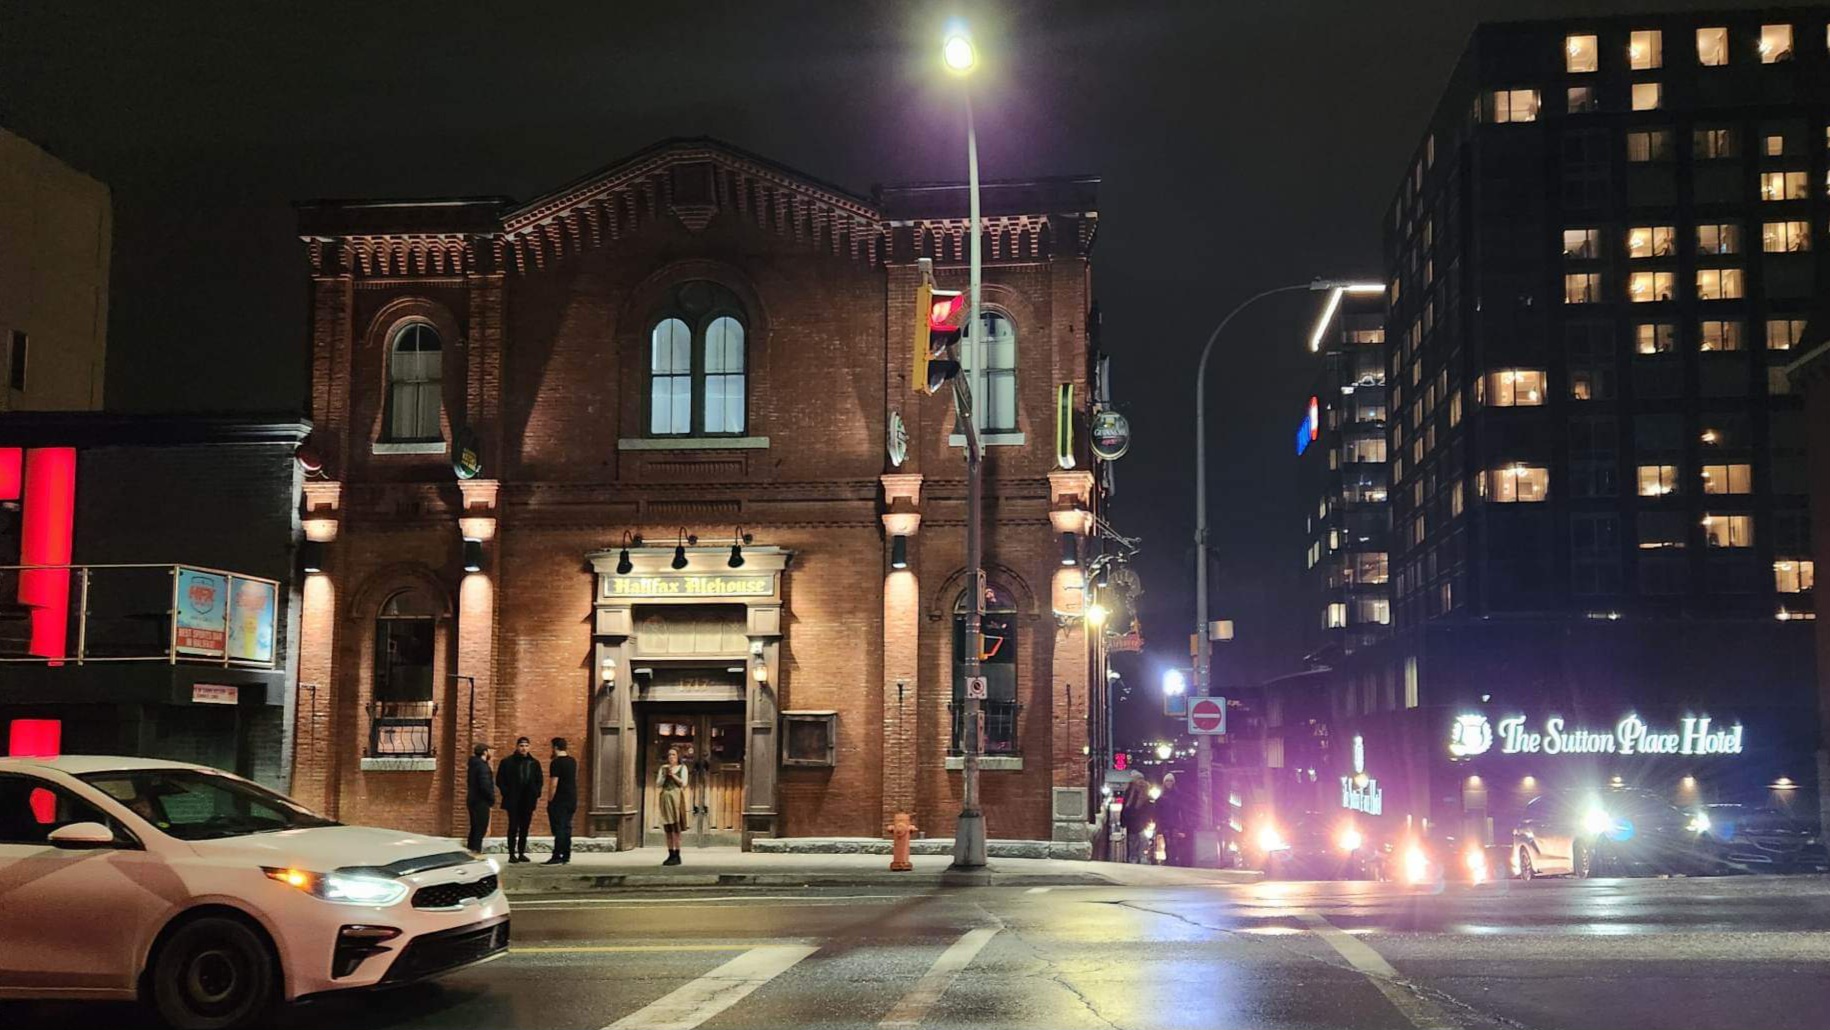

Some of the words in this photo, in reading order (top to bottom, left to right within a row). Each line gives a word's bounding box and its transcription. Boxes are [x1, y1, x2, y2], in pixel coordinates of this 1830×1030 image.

[614, 578, 679, 593] Halifax
[685, 577, 766, 593] Alehouse
[1499, 715, 1541, 754] The
[1543, 718, 1615, 754] Sutton
[1617, 714, 1679, 754] Place
[1679, 716, 1743, 755] Hotel
